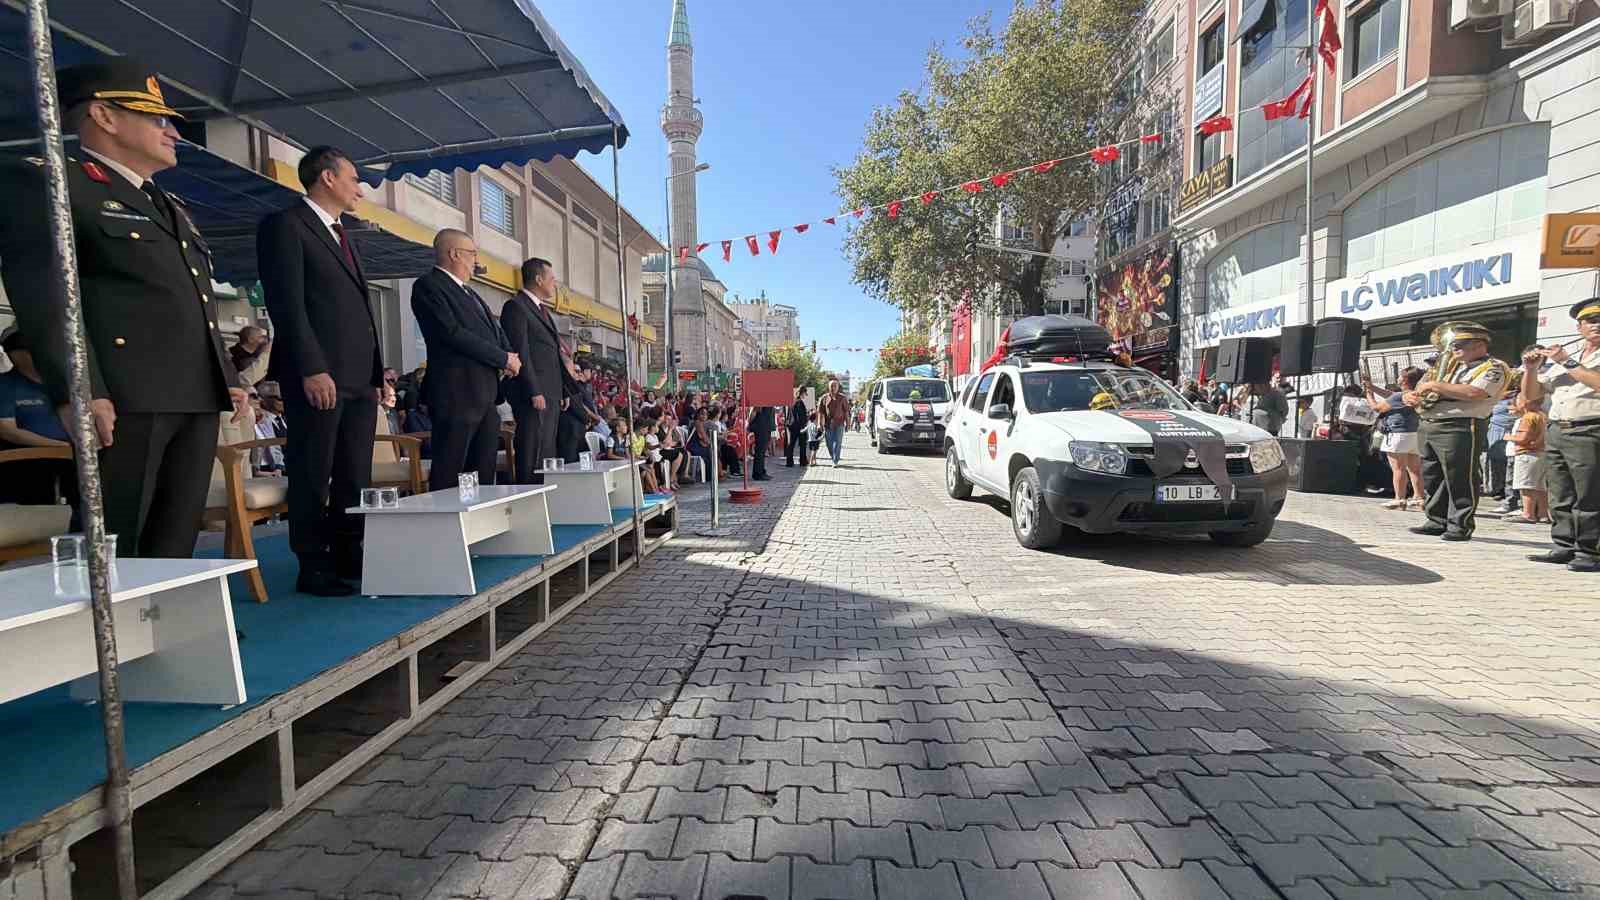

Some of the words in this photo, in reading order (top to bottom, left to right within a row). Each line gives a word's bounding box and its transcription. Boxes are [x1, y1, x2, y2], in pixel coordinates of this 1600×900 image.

[1181, 171, 1210, 198] KAYA
[1341, 285, 1374, 313] LC
[1166, 487, 1177, 499] 10
[1189, 487, 1203, 499] LB
